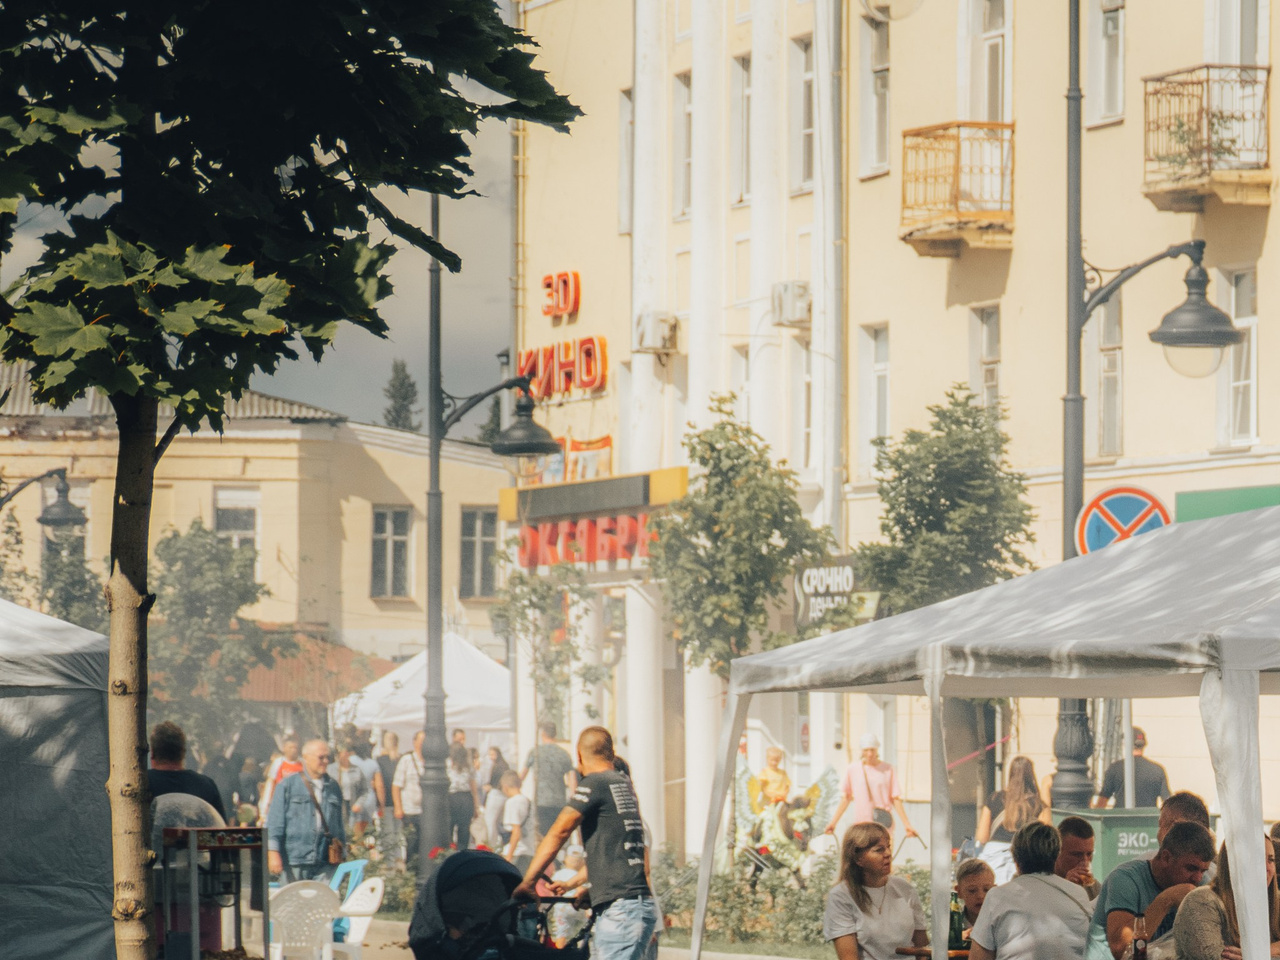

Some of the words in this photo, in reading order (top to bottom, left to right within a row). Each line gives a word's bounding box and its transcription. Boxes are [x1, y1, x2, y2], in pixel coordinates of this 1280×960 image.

[542, 270, 581, 317] 3D
[517, 335, 608, 399] КИНО
[517, 512, 659, 568] ОКТЯБРЬ
[802, 565, 854, 594] СРОЧНО
